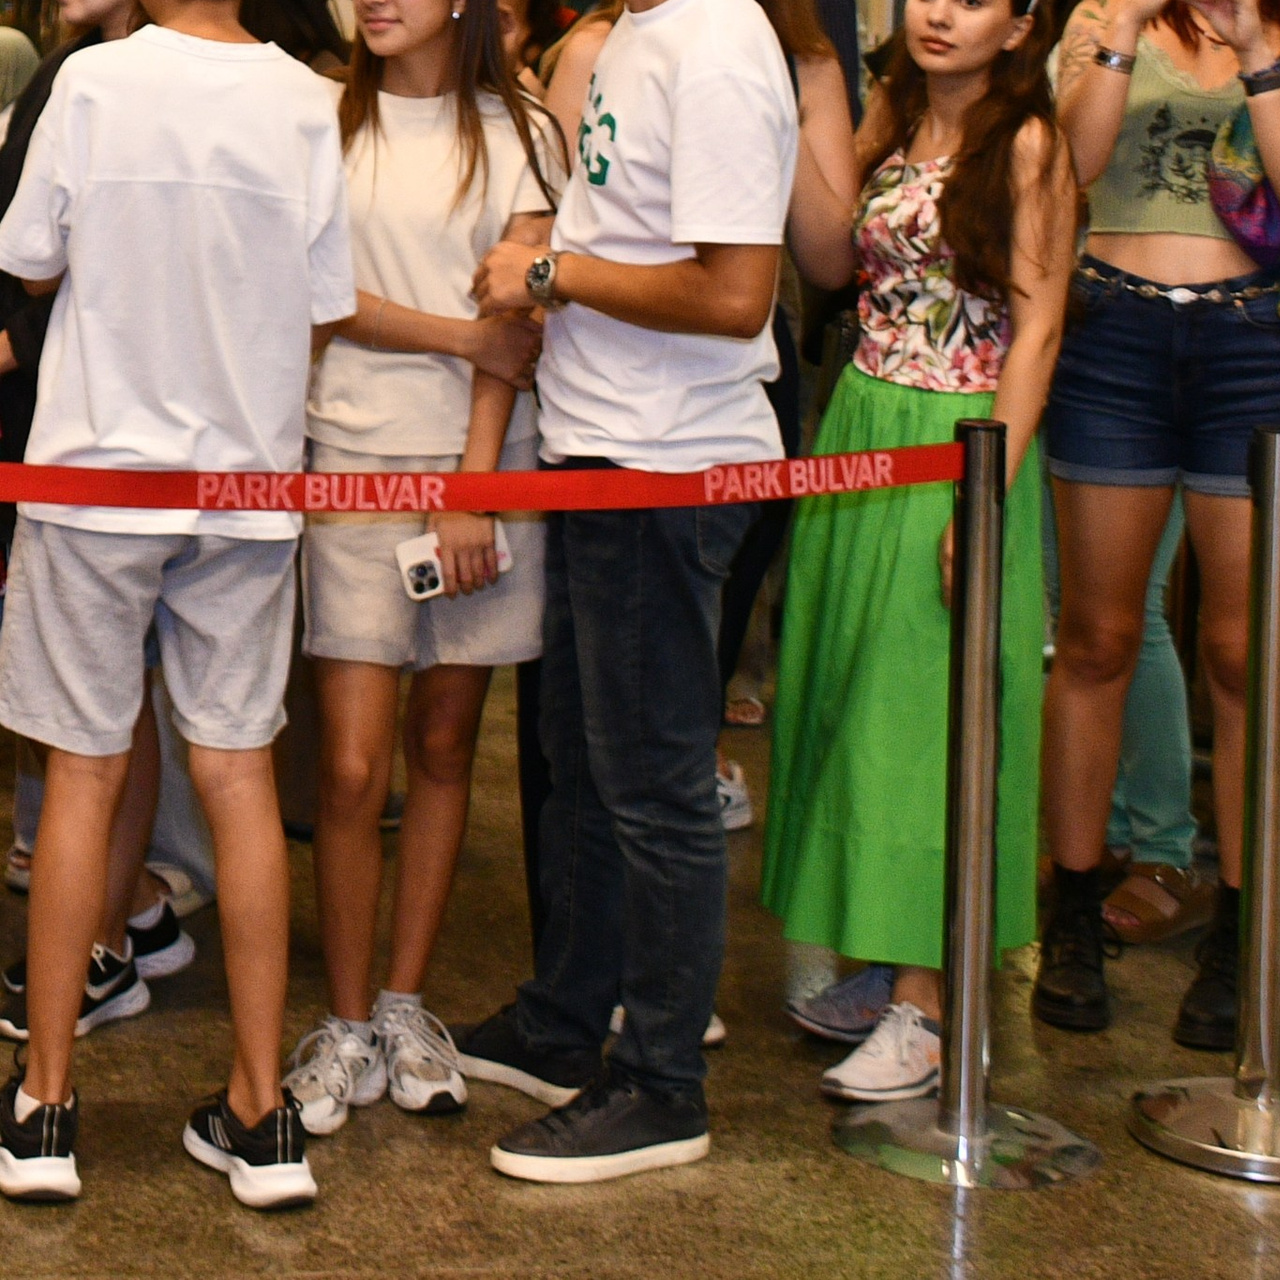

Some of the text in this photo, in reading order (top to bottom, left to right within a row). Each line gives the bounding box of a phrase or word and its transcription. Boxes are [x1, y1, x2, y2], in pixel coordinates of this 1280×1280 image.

[196, 473, 446, 511] PARK BULVAR
[703, 452, 894, 503] PARK BULVAR
